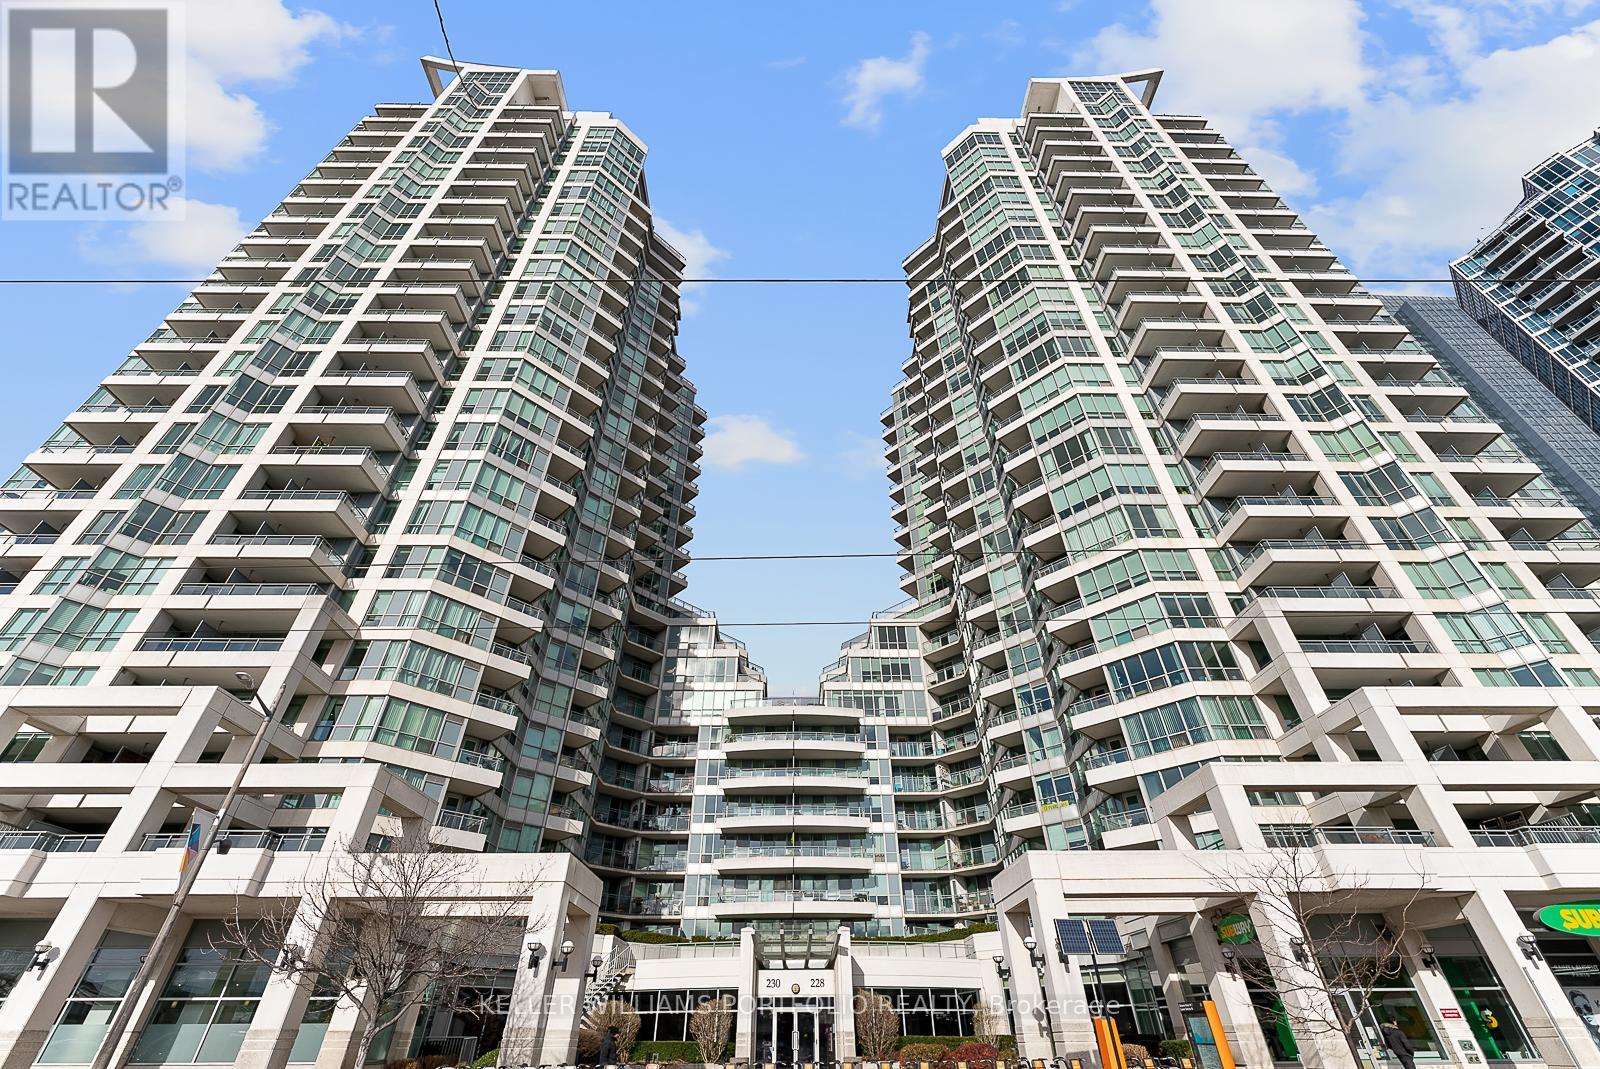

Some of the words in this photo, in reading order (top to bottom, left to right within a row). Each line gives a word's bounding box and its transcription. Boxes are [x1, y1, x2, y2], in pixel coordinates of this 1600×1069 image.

[1221, 920, 1253, 938] SUBWAY
[766, 978, 781, 988] 230
[810, 978, 825, 988] 228
